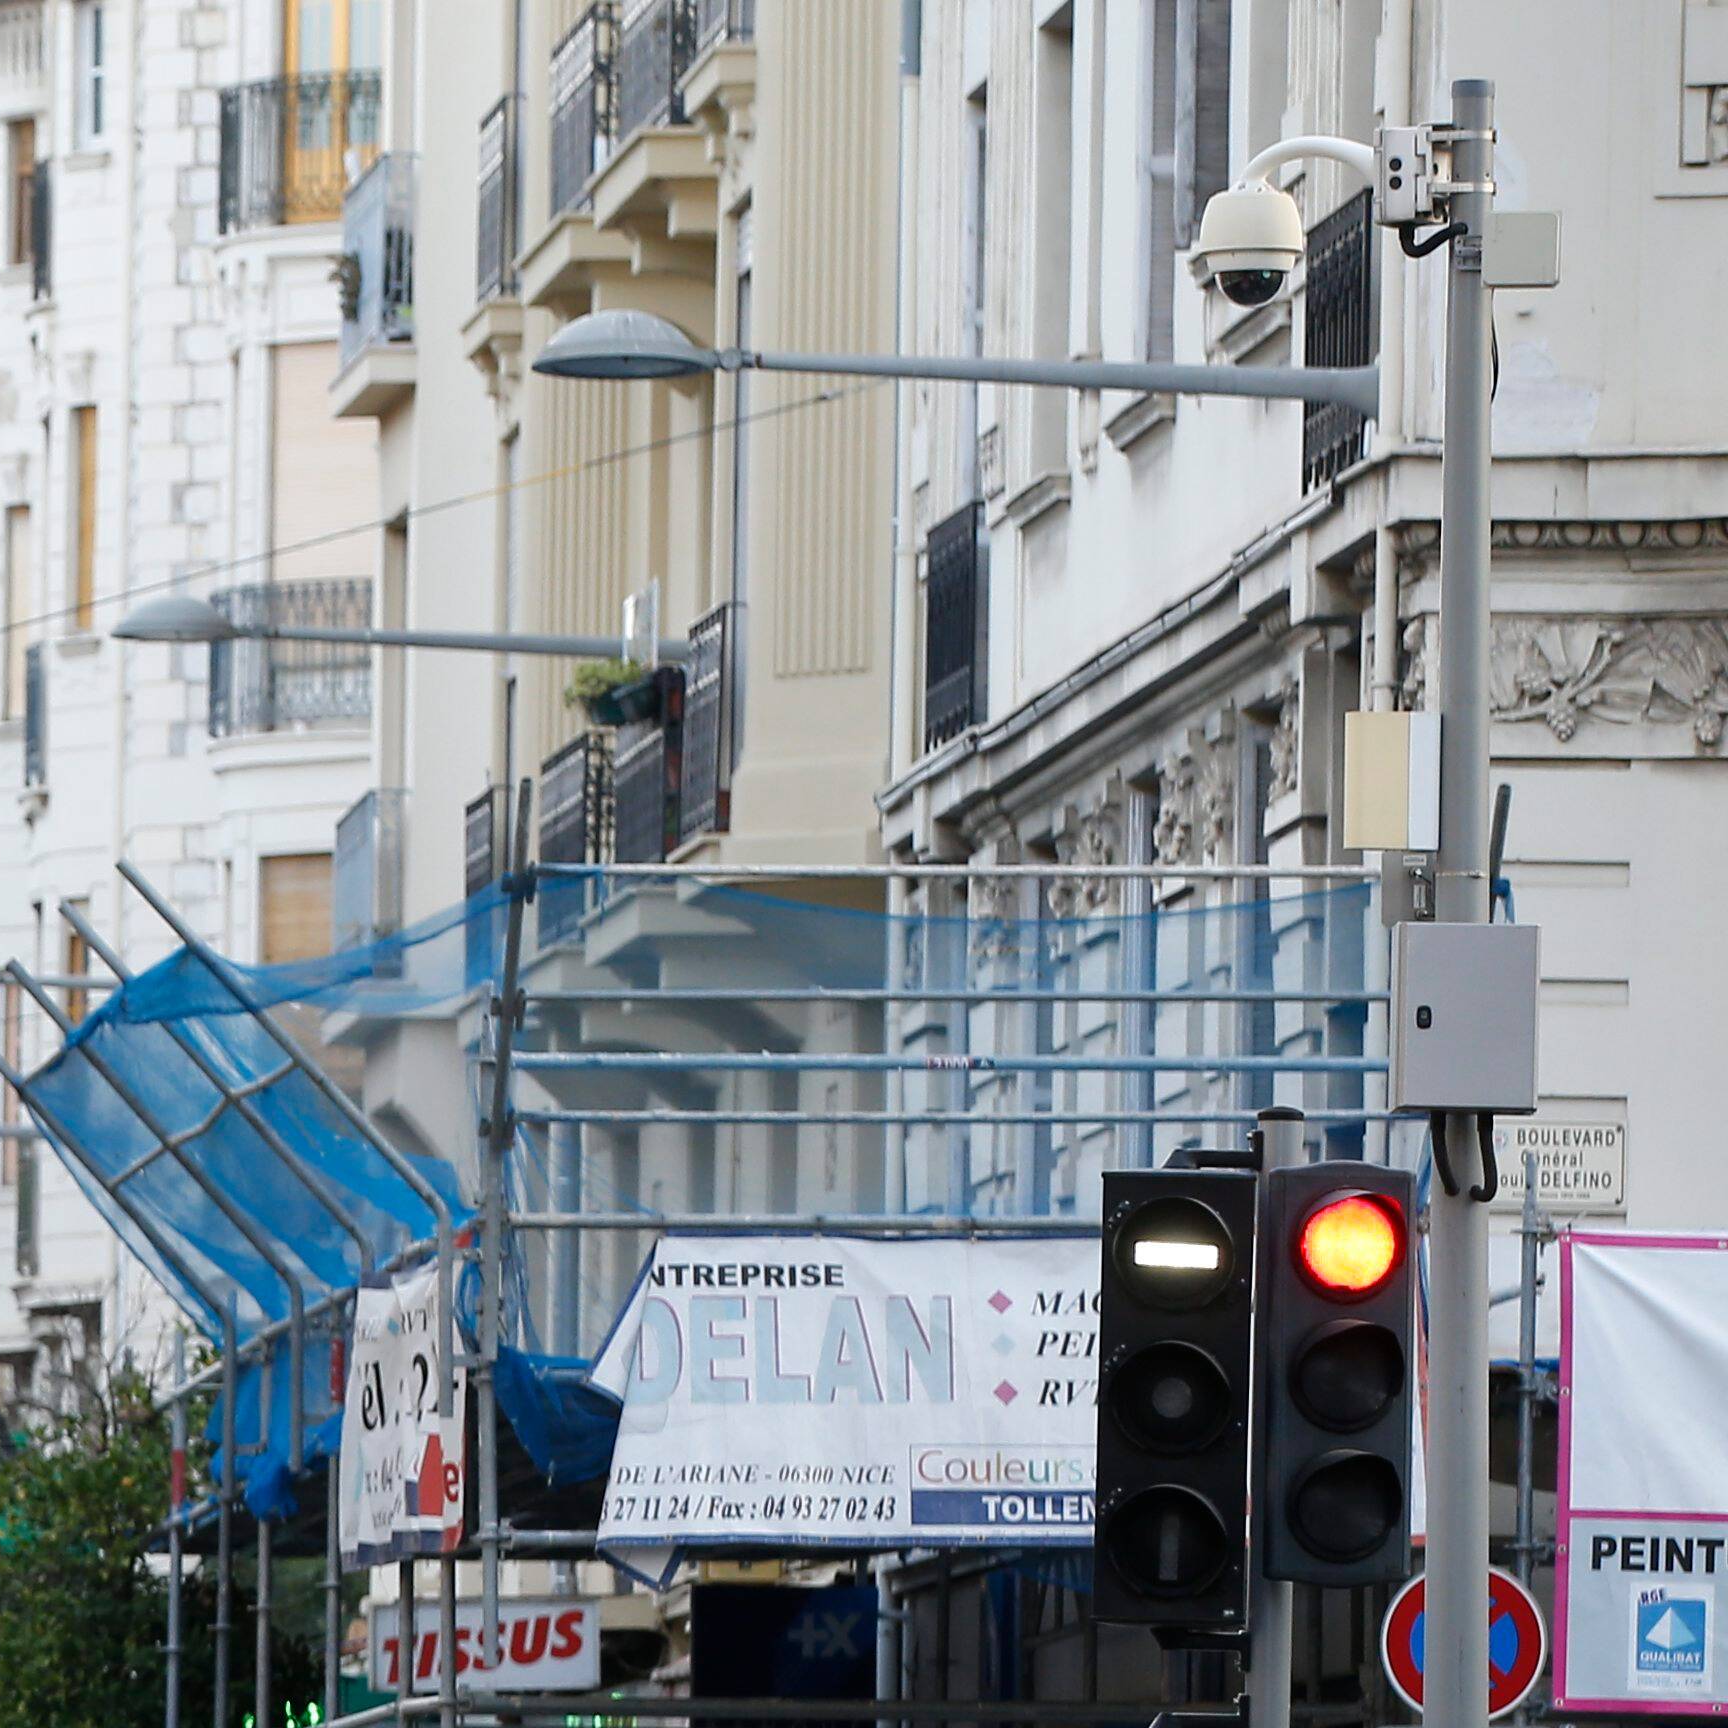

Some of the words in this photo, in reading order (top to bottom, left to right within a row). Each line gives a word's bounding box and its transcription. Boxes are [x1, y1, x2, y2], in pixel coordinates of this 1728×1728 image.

[1517, 1127, 1616, 1147] BOULEVARD
[1520, 1150, 1584, 1168] Gnéral
[1541, 1171, 1613, 1190] DELFINO
[615, 1464, 643, 1485] DE
[653, 1463, 760, 1485] L'ARIANE
[778, 1464, 834, 1484] 06300
[839, 1463, 896, 1485] NICE
[917, 1449, 1084, 1484] Couleurs
[613, 1495, 637, 1521] 27
[643, 1496, 661, 1521] 11
[667, 1494, 690, 1520] 24
[708, 1495, 745, 1520] Fax
[762, 1495, 785, 1519] 04
[792, 1495, 812, 1519] 93
[818, 1496, 841, 1521] 27
[845, 1496, 868, 1521] 02
[872, 1496, 897, 1520] 43
[382, 1608, 586, 1685] TISSUS
[1639, 1650, 1702, 1665] QUALIBAT
